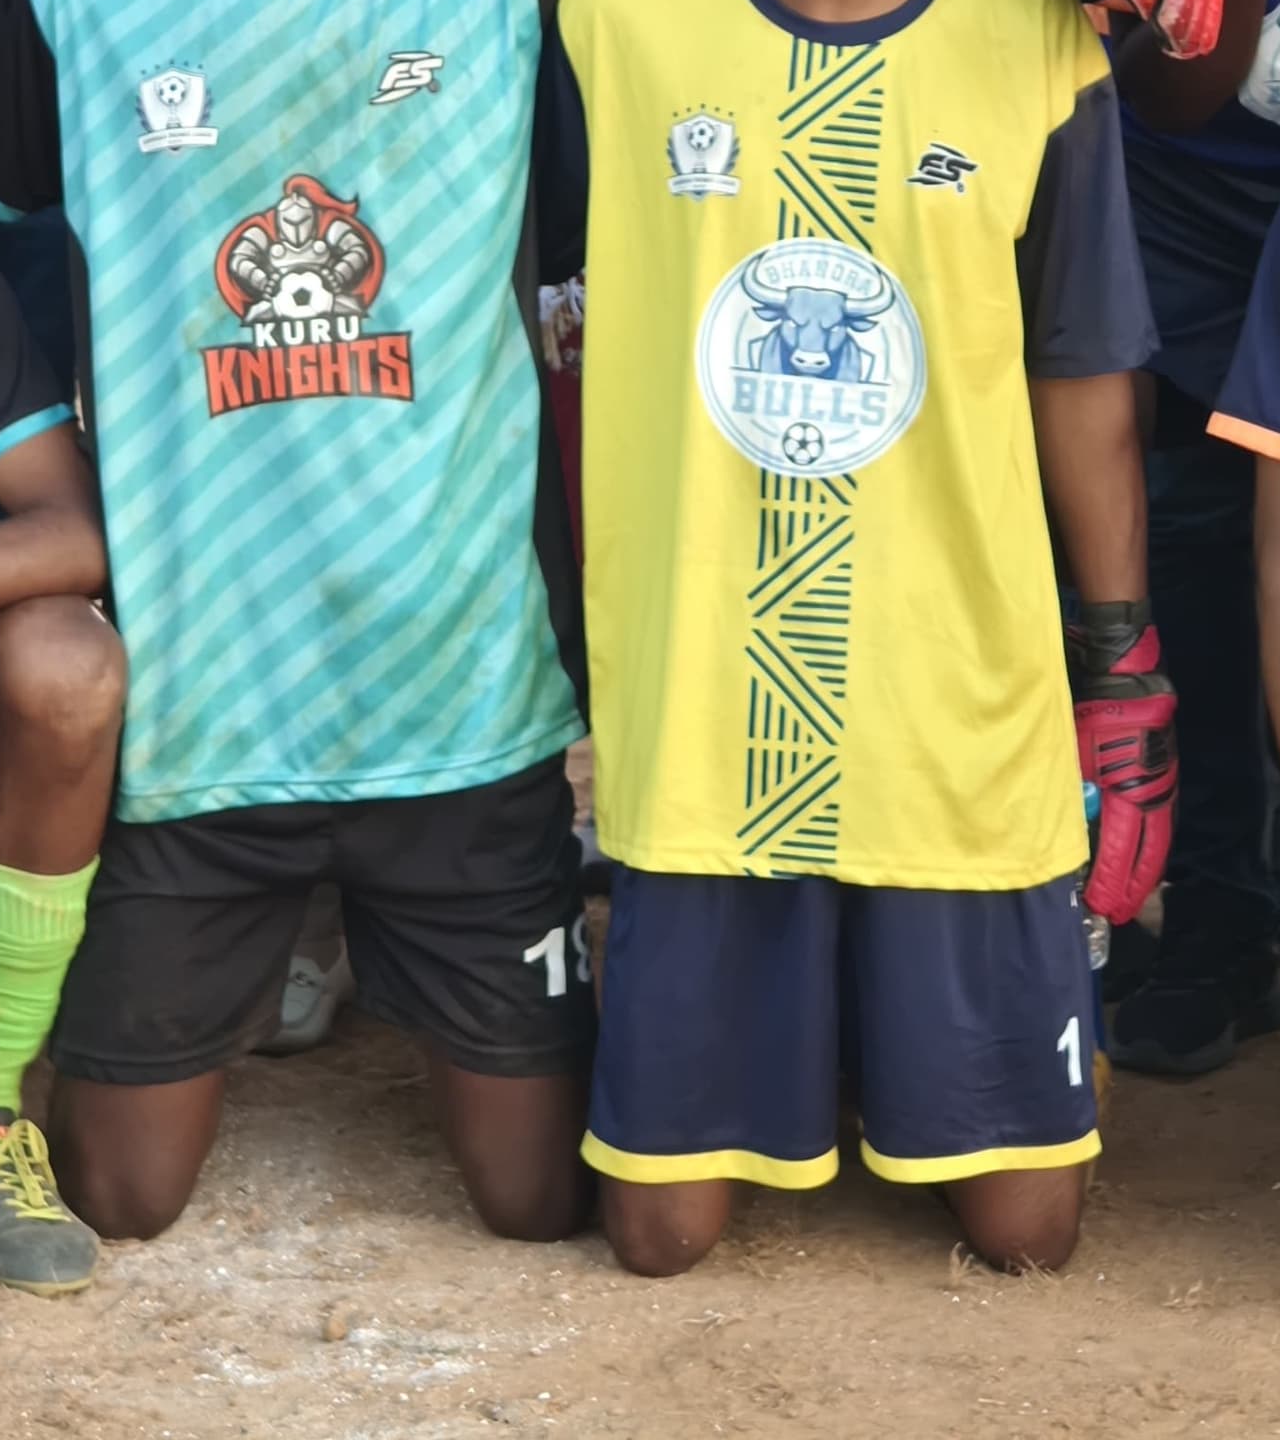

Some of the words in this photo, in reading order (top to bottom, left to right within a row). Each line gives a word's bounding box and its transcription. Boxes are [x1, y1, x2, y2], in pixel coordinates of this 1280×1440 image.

[763, 259, 877, 298] BHANDRA
[254, 318, 360, 347] KURU
[202, 333, 413, 416] KNIGHTS
[732, 375, 889, 429] BULLS
[1056, 1015, 1084, 1088] 1
